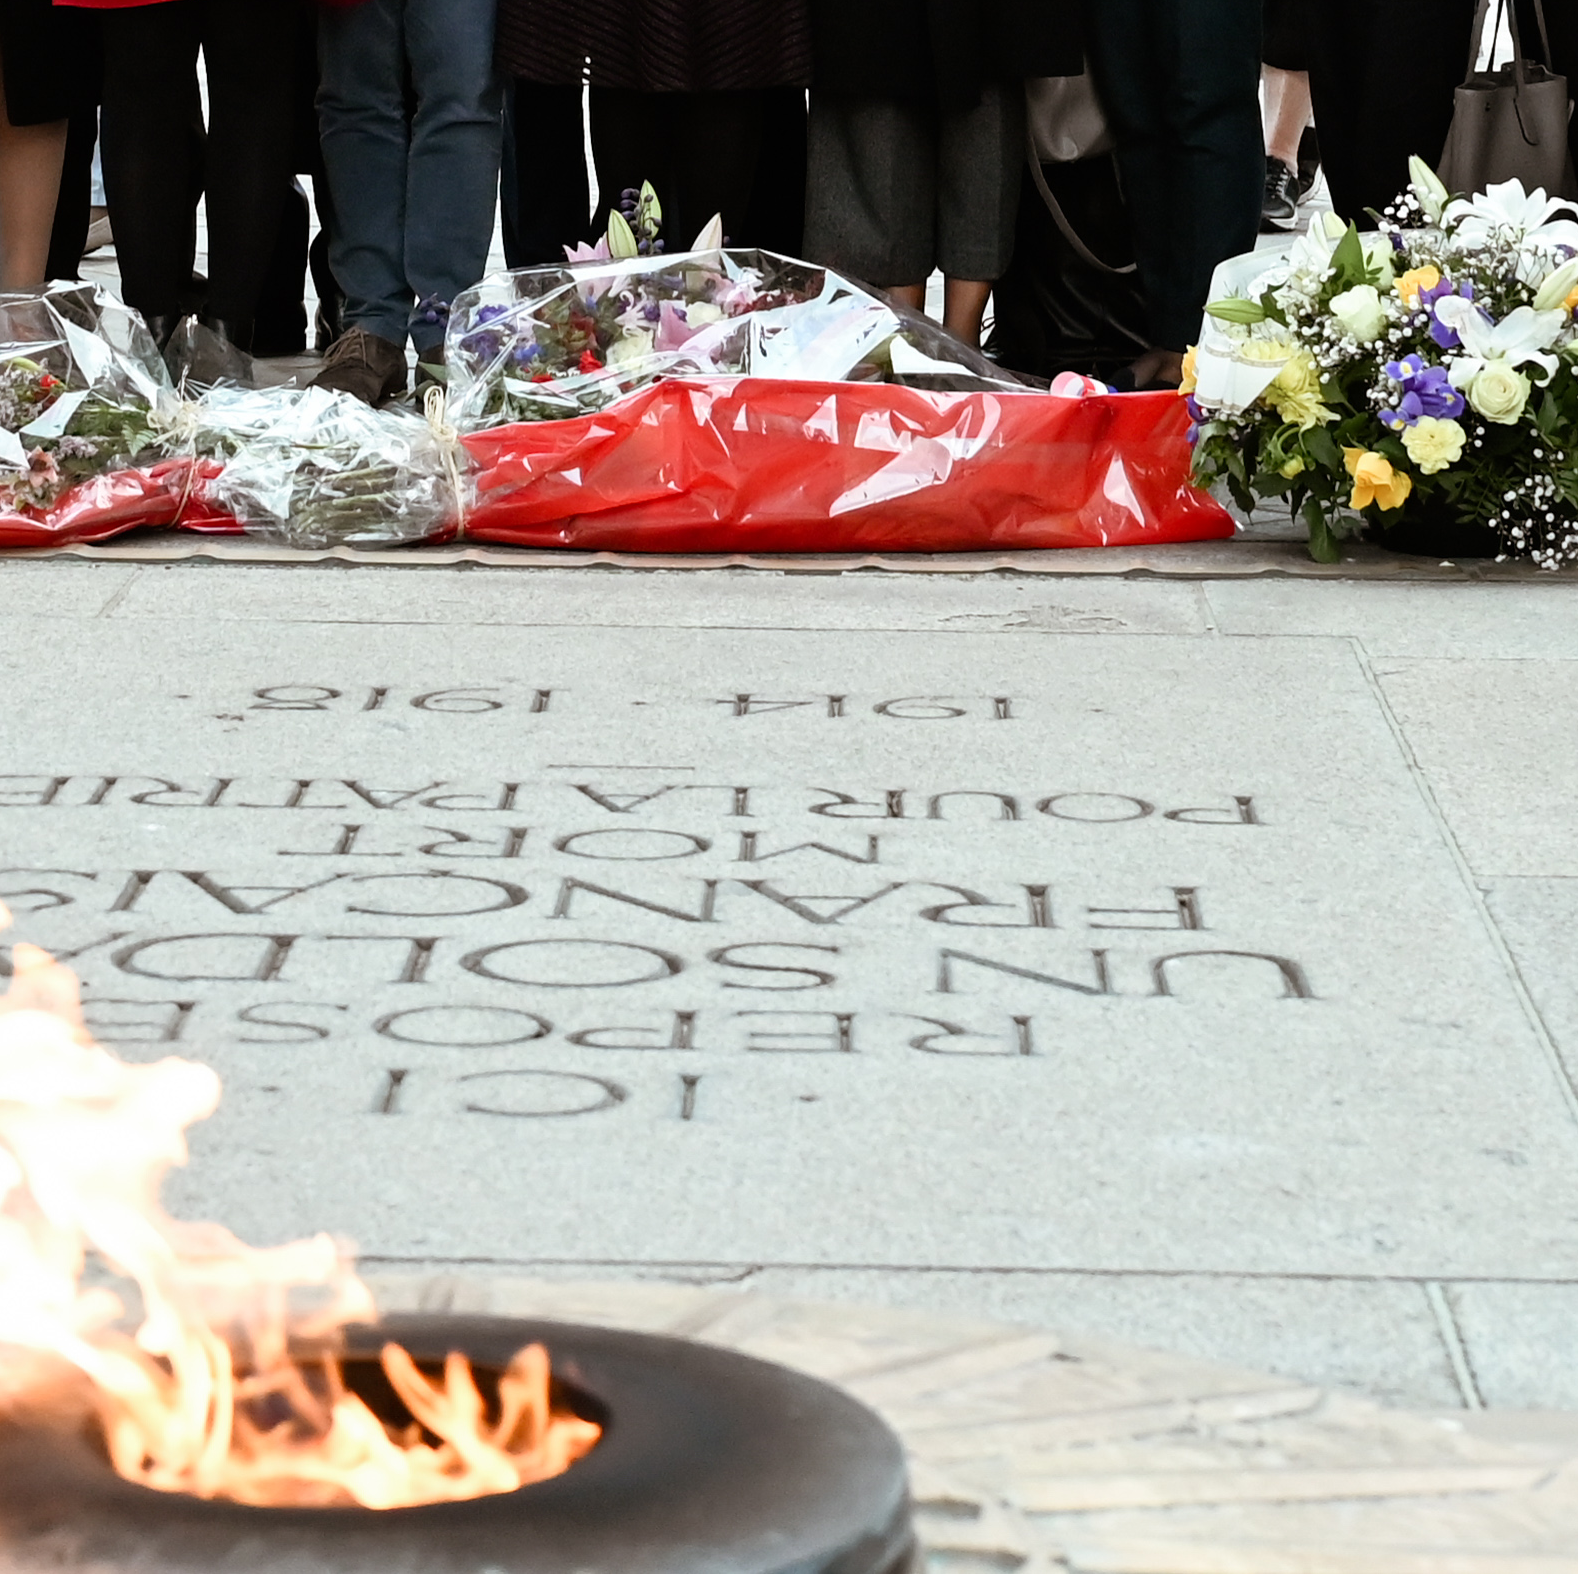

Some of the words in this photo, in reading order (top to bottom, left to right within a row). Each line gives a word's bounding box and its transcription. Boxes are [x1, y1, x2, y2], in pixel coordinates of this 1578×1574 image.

[246, 685, 554, 714] 1918
[706, 692, 1014, 719] 1914
[566, 782, 753, 817] LA
[805, 787, 1266, 825] POUR
[275, 824, 882, 863] MORT
[933, 948, 1322, 1001] UN
[80, 1000, 1039, 1057] REPOSE
[370, 1069, 702, 1119] ICI
